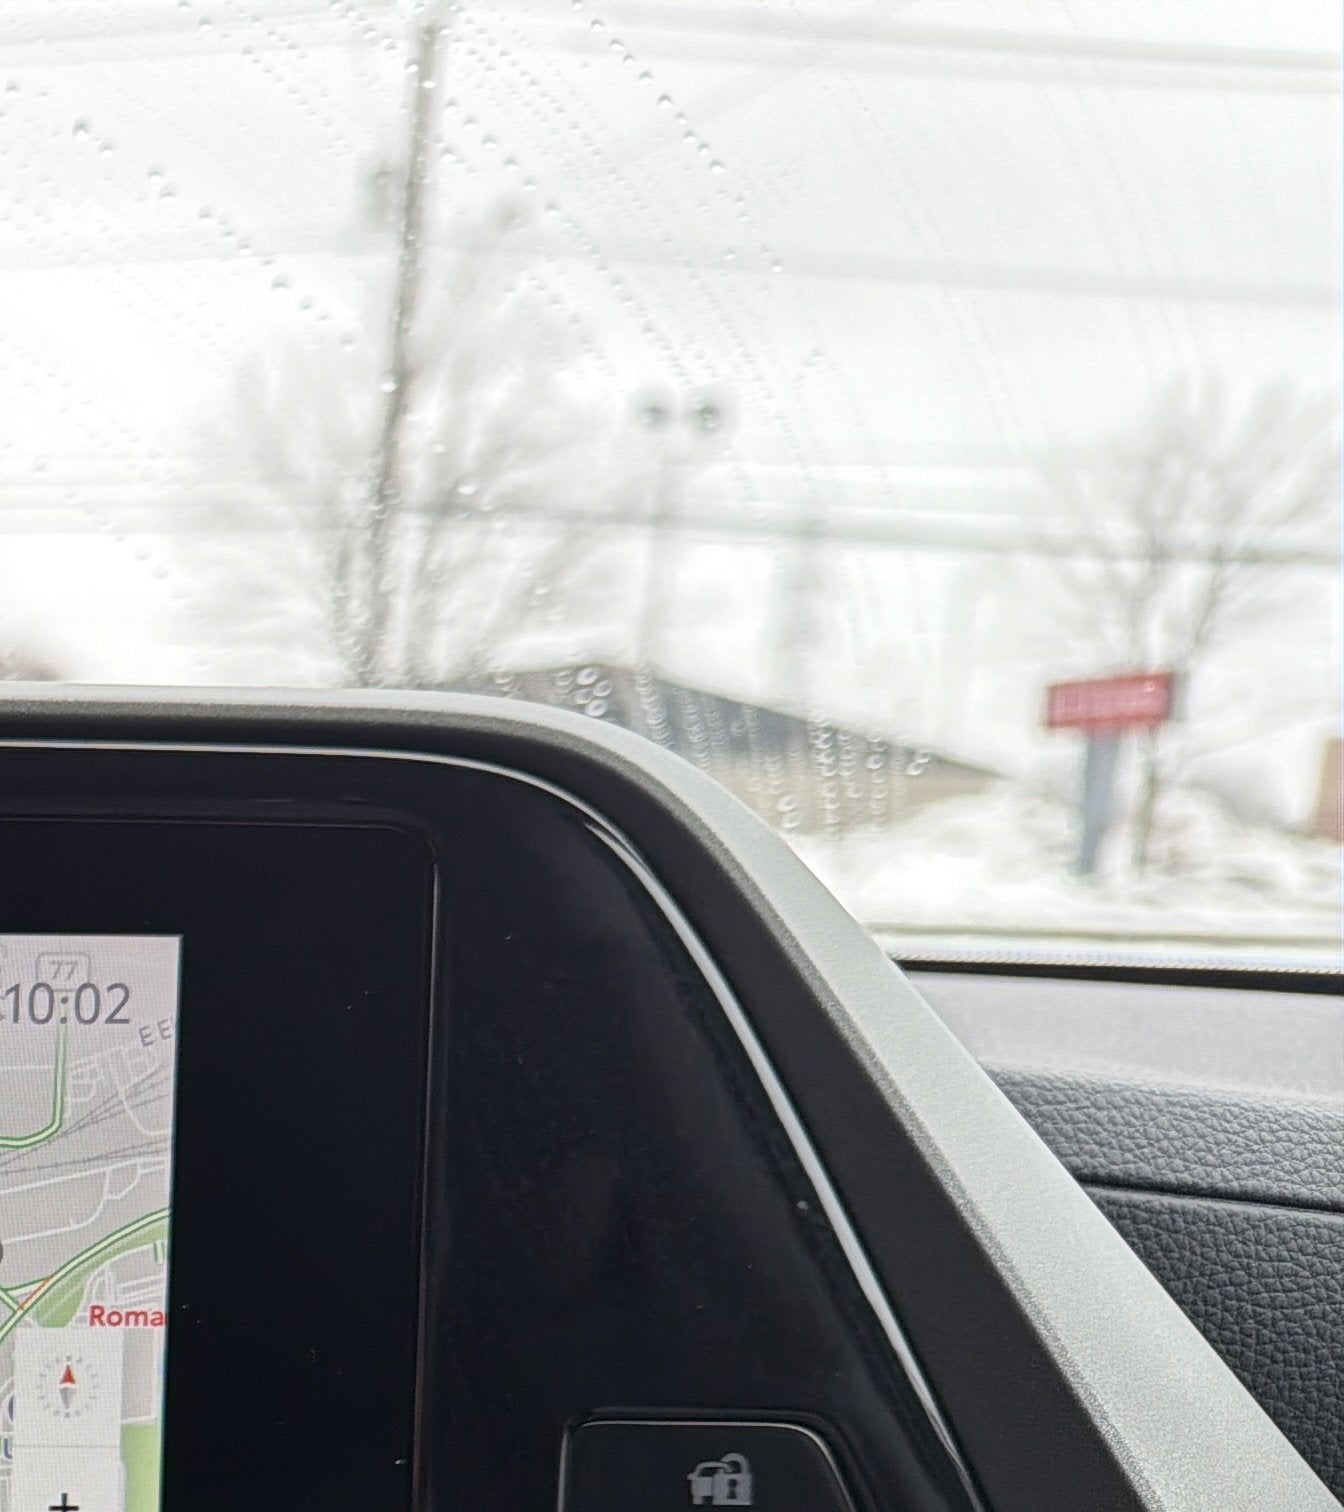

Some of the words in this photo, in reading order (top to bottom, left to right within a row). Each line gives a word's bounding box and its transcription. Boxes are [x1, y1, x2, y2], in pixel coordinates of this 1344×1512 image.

[4, 982, 132, 1026] 10:02
[157, 1017, 174, 1040] E
[88, 1304, 167, 1328] Roma
